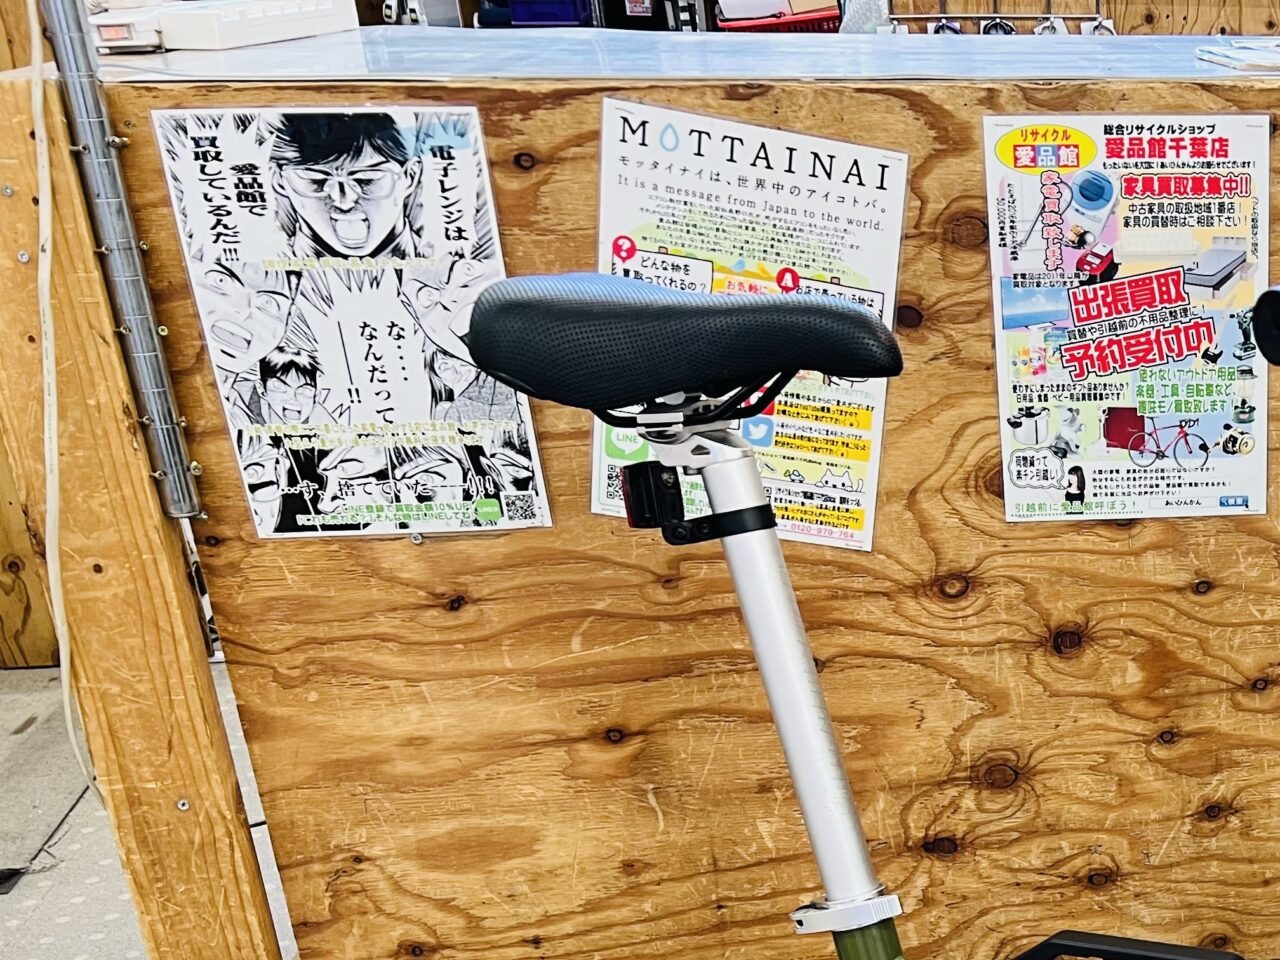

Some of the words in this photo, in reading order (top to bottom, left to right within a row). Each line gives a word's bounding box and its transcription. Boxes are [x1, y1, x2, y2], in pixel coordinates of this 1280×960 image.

[1020, 128, 1071, 142] リサイクル
[1103, 124, 1216, 136] 総合リサイクルショップ
[1015, 146, 1078, 167] 愛品館
[1105, 136, 1229, 159] 愛品館千葉店
[430, 145, 470, 241] 電子レンジは
[617, 174, 631, 187] It
[634, 177, 646, 189] is
[651, 183, 659, 193] a
[665, 184, 721, 204] message
[727, 194, 757, 209] from
[761, 200, 798, 220] Japan
[803, 207, 816, 219] to
[820, 210, 841, 224] the
[640, 256, 692, 277] どんな物を
[1070, 270, 1187, 325] 出張買取
[1063, 320, 1215, 380] 予約受付中
[1138, 367, 1237, 383] 使わないアウトドア用品
[617, 433, 639, 444] LINE
[790, 524, 855, 540] 0120-979-764
